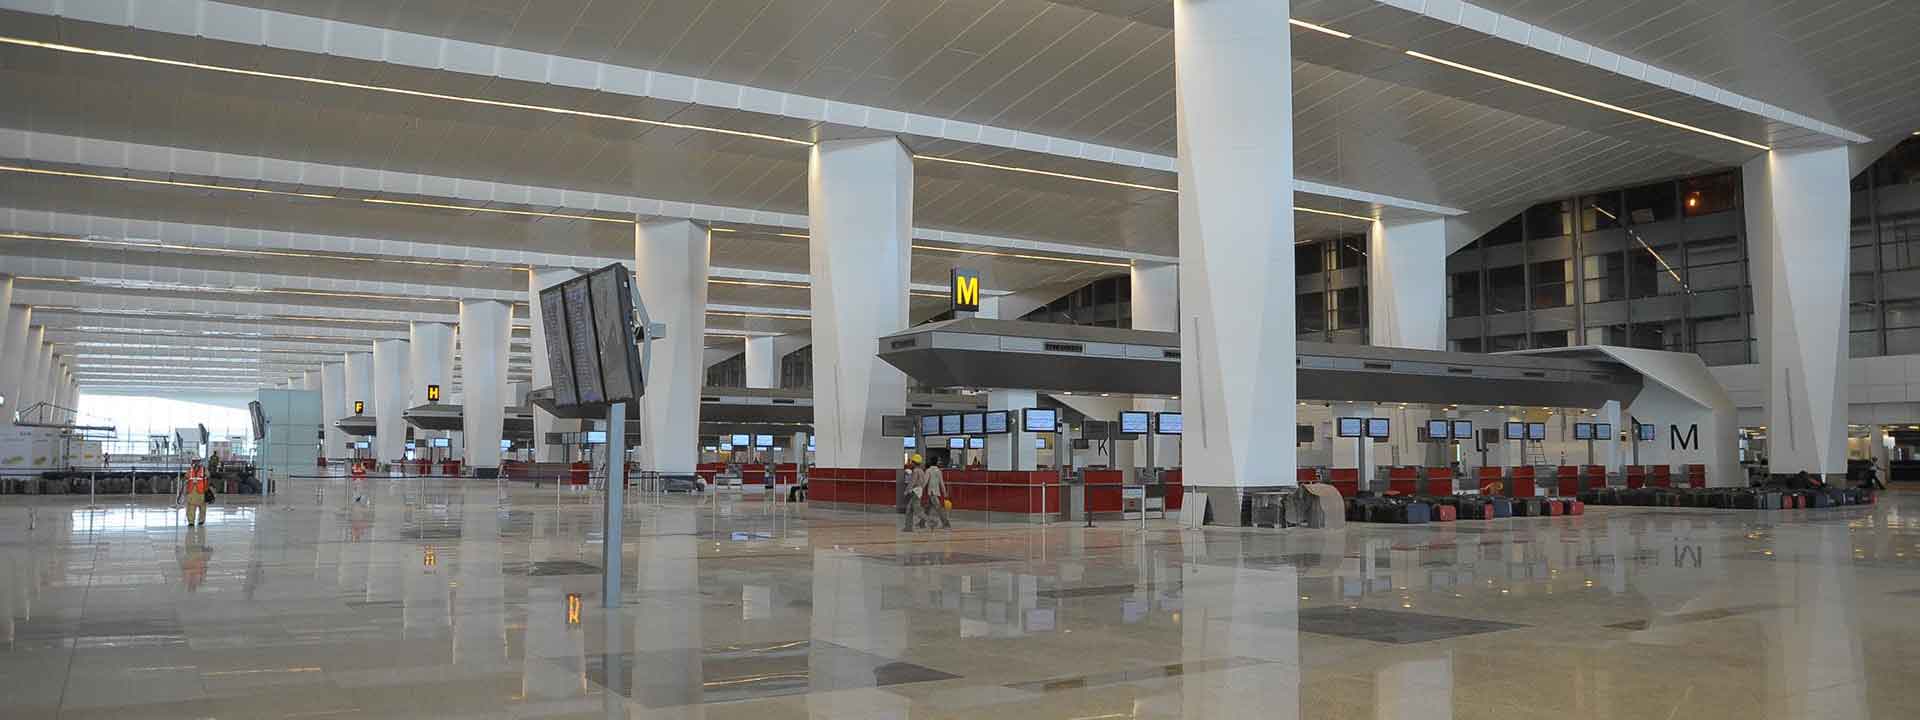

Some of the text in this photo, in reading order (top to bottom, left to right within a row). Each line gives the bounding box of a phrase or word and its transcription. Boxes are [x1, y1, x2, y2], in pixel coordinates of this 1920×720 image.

[957, 276, 978, 305] M
[429, 386, 438, 399] H
[355, 402, 362, 413] F
[1670, 424, 1698, 450] M
